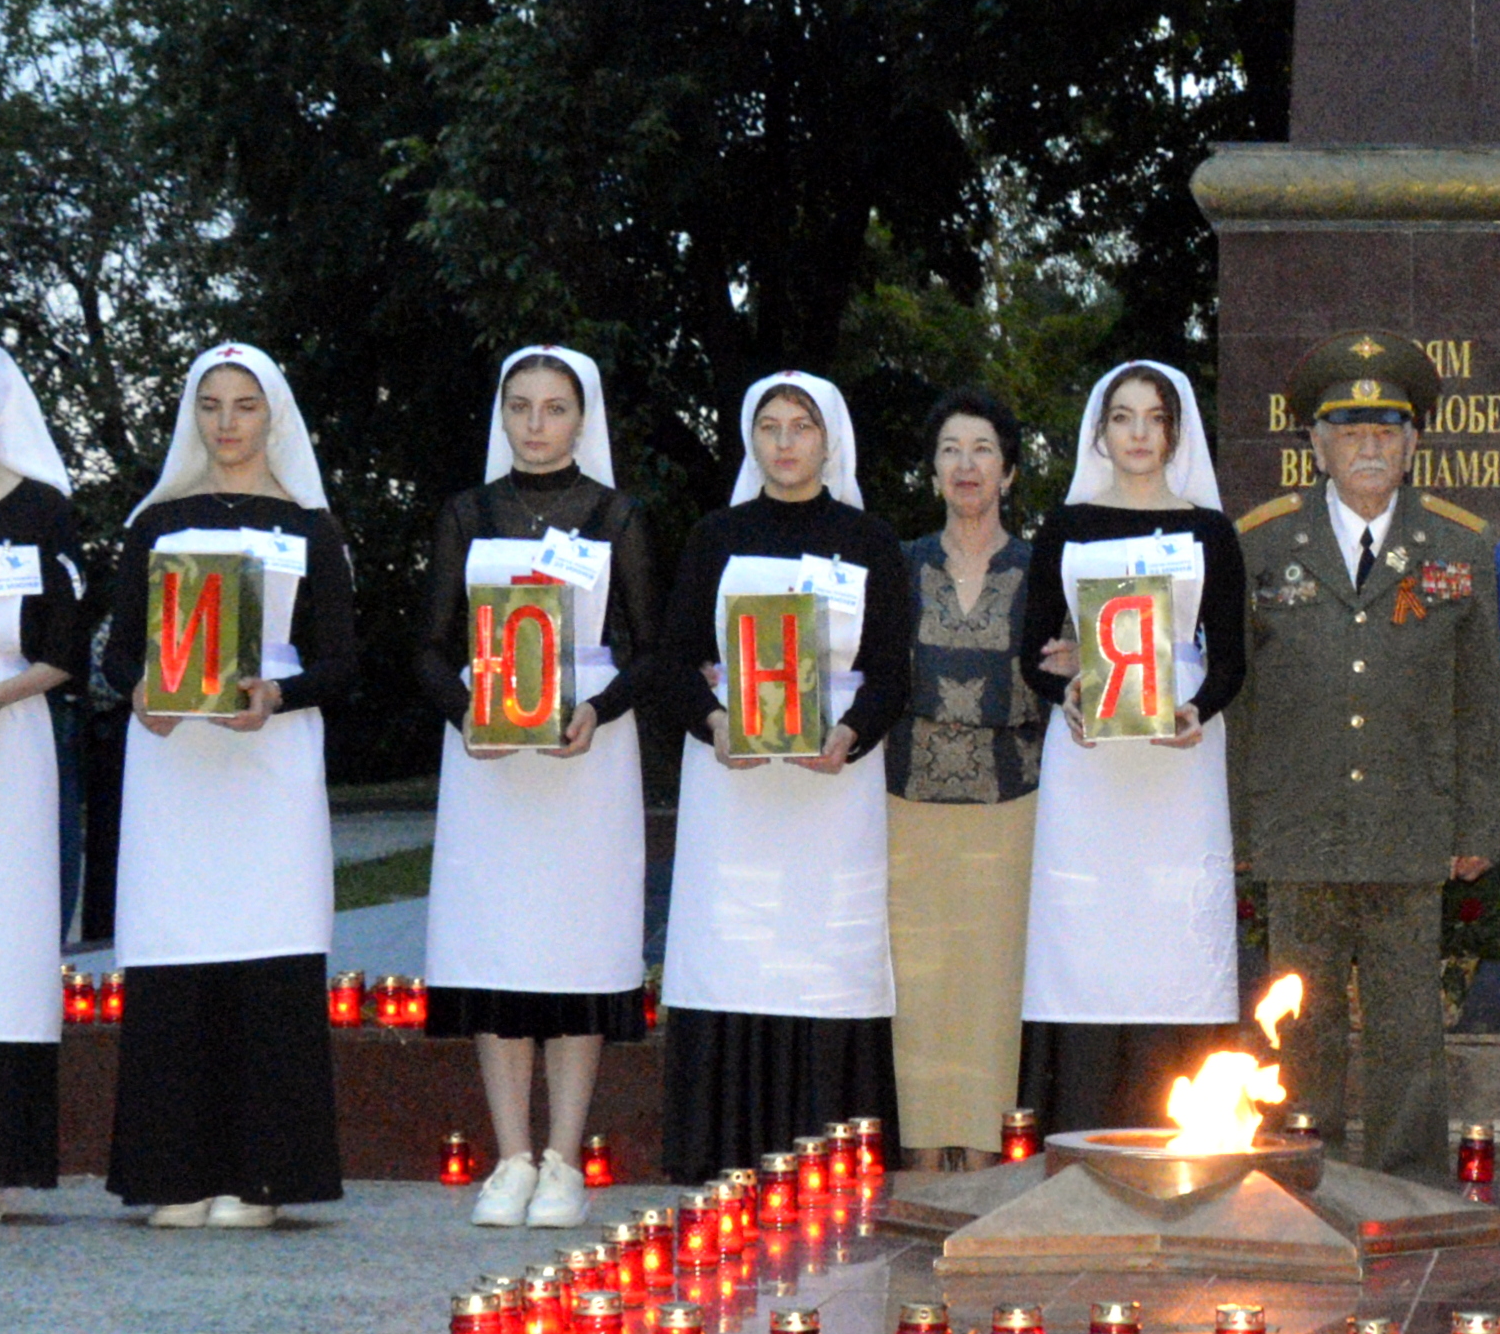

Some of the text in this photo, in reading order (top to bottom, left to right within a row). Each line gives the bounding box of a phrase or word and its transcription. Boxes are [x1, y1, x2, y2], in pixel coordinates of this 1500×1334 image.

[160, 572, 223, 696] И
[472, 604, 557, 729] Ю
[739, 613, 803, 737] Н
[1098, 594, 1158, 719] Я
